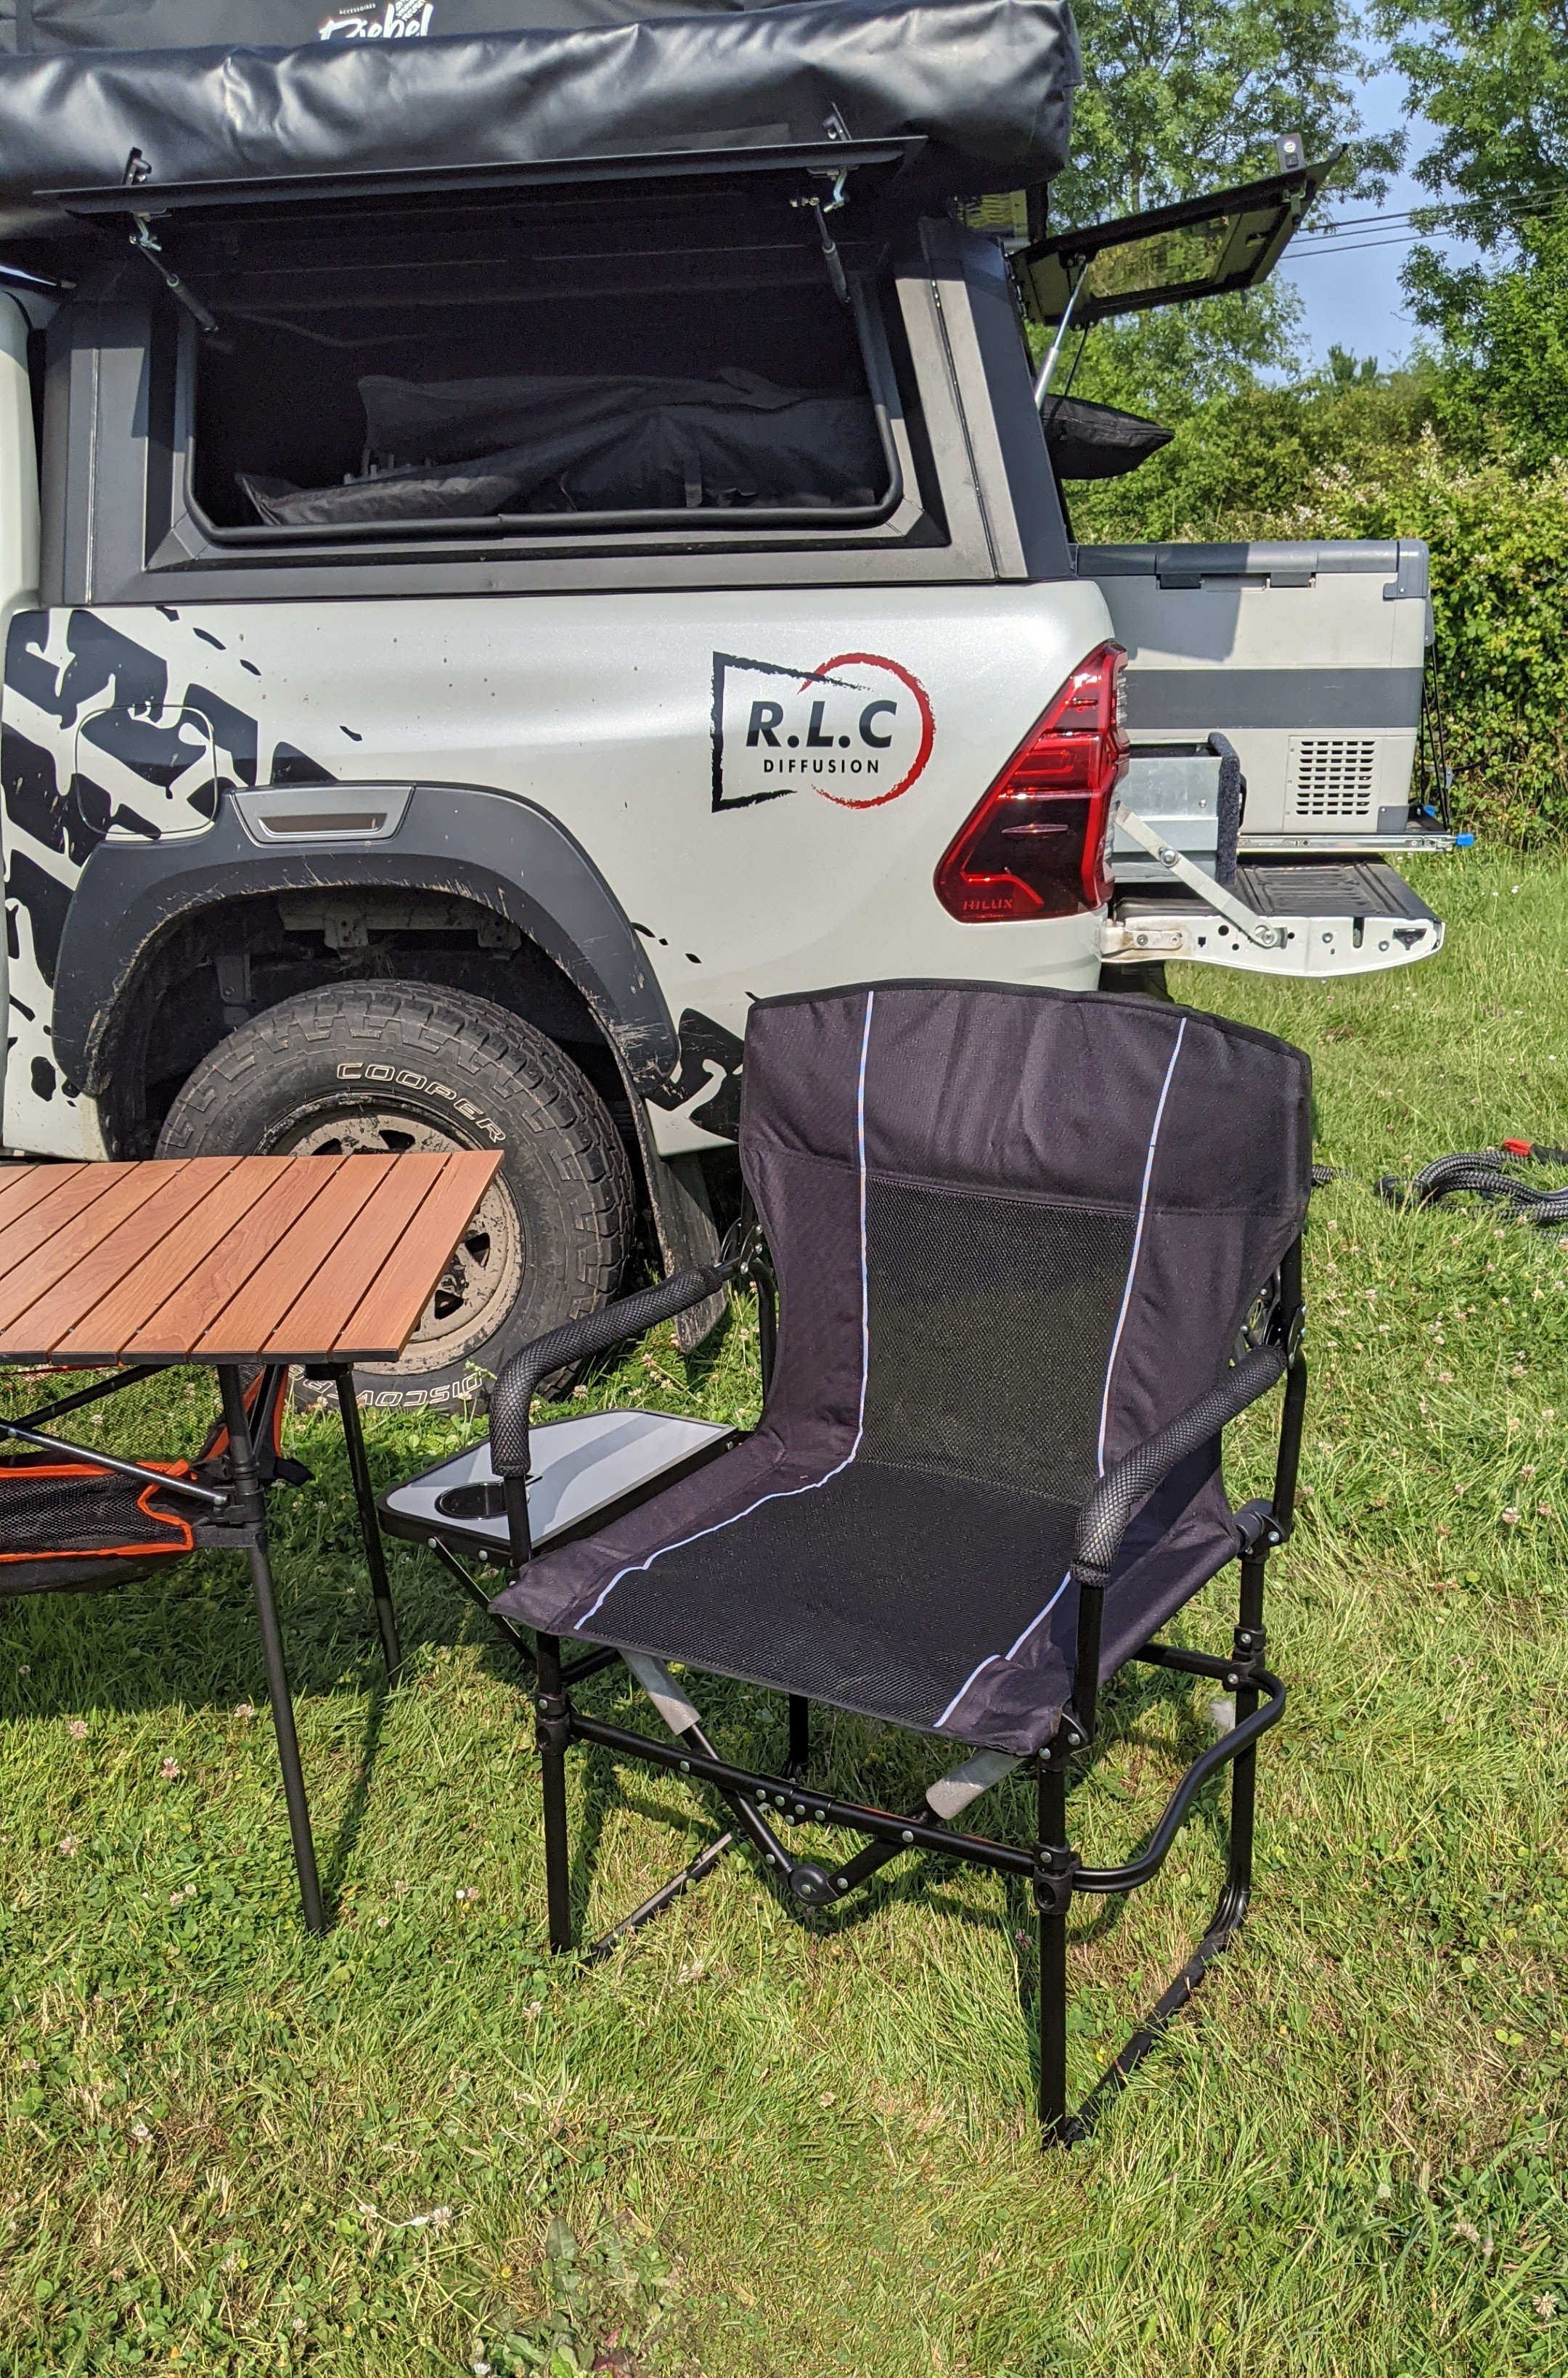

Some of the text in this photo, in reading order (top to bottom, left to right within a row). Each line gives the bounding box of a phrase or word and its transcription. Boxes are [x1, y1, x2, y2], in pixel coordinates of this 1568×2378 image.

[339, 3, 376, 15] ACCESSOIRES
[746, 700, 897, 748] R.L.C
[764, 759, 879, 774] DIFFUSION
[963, 899, 1013, 910] HILUX
[336, 1062, 506, 1143] COOPER
